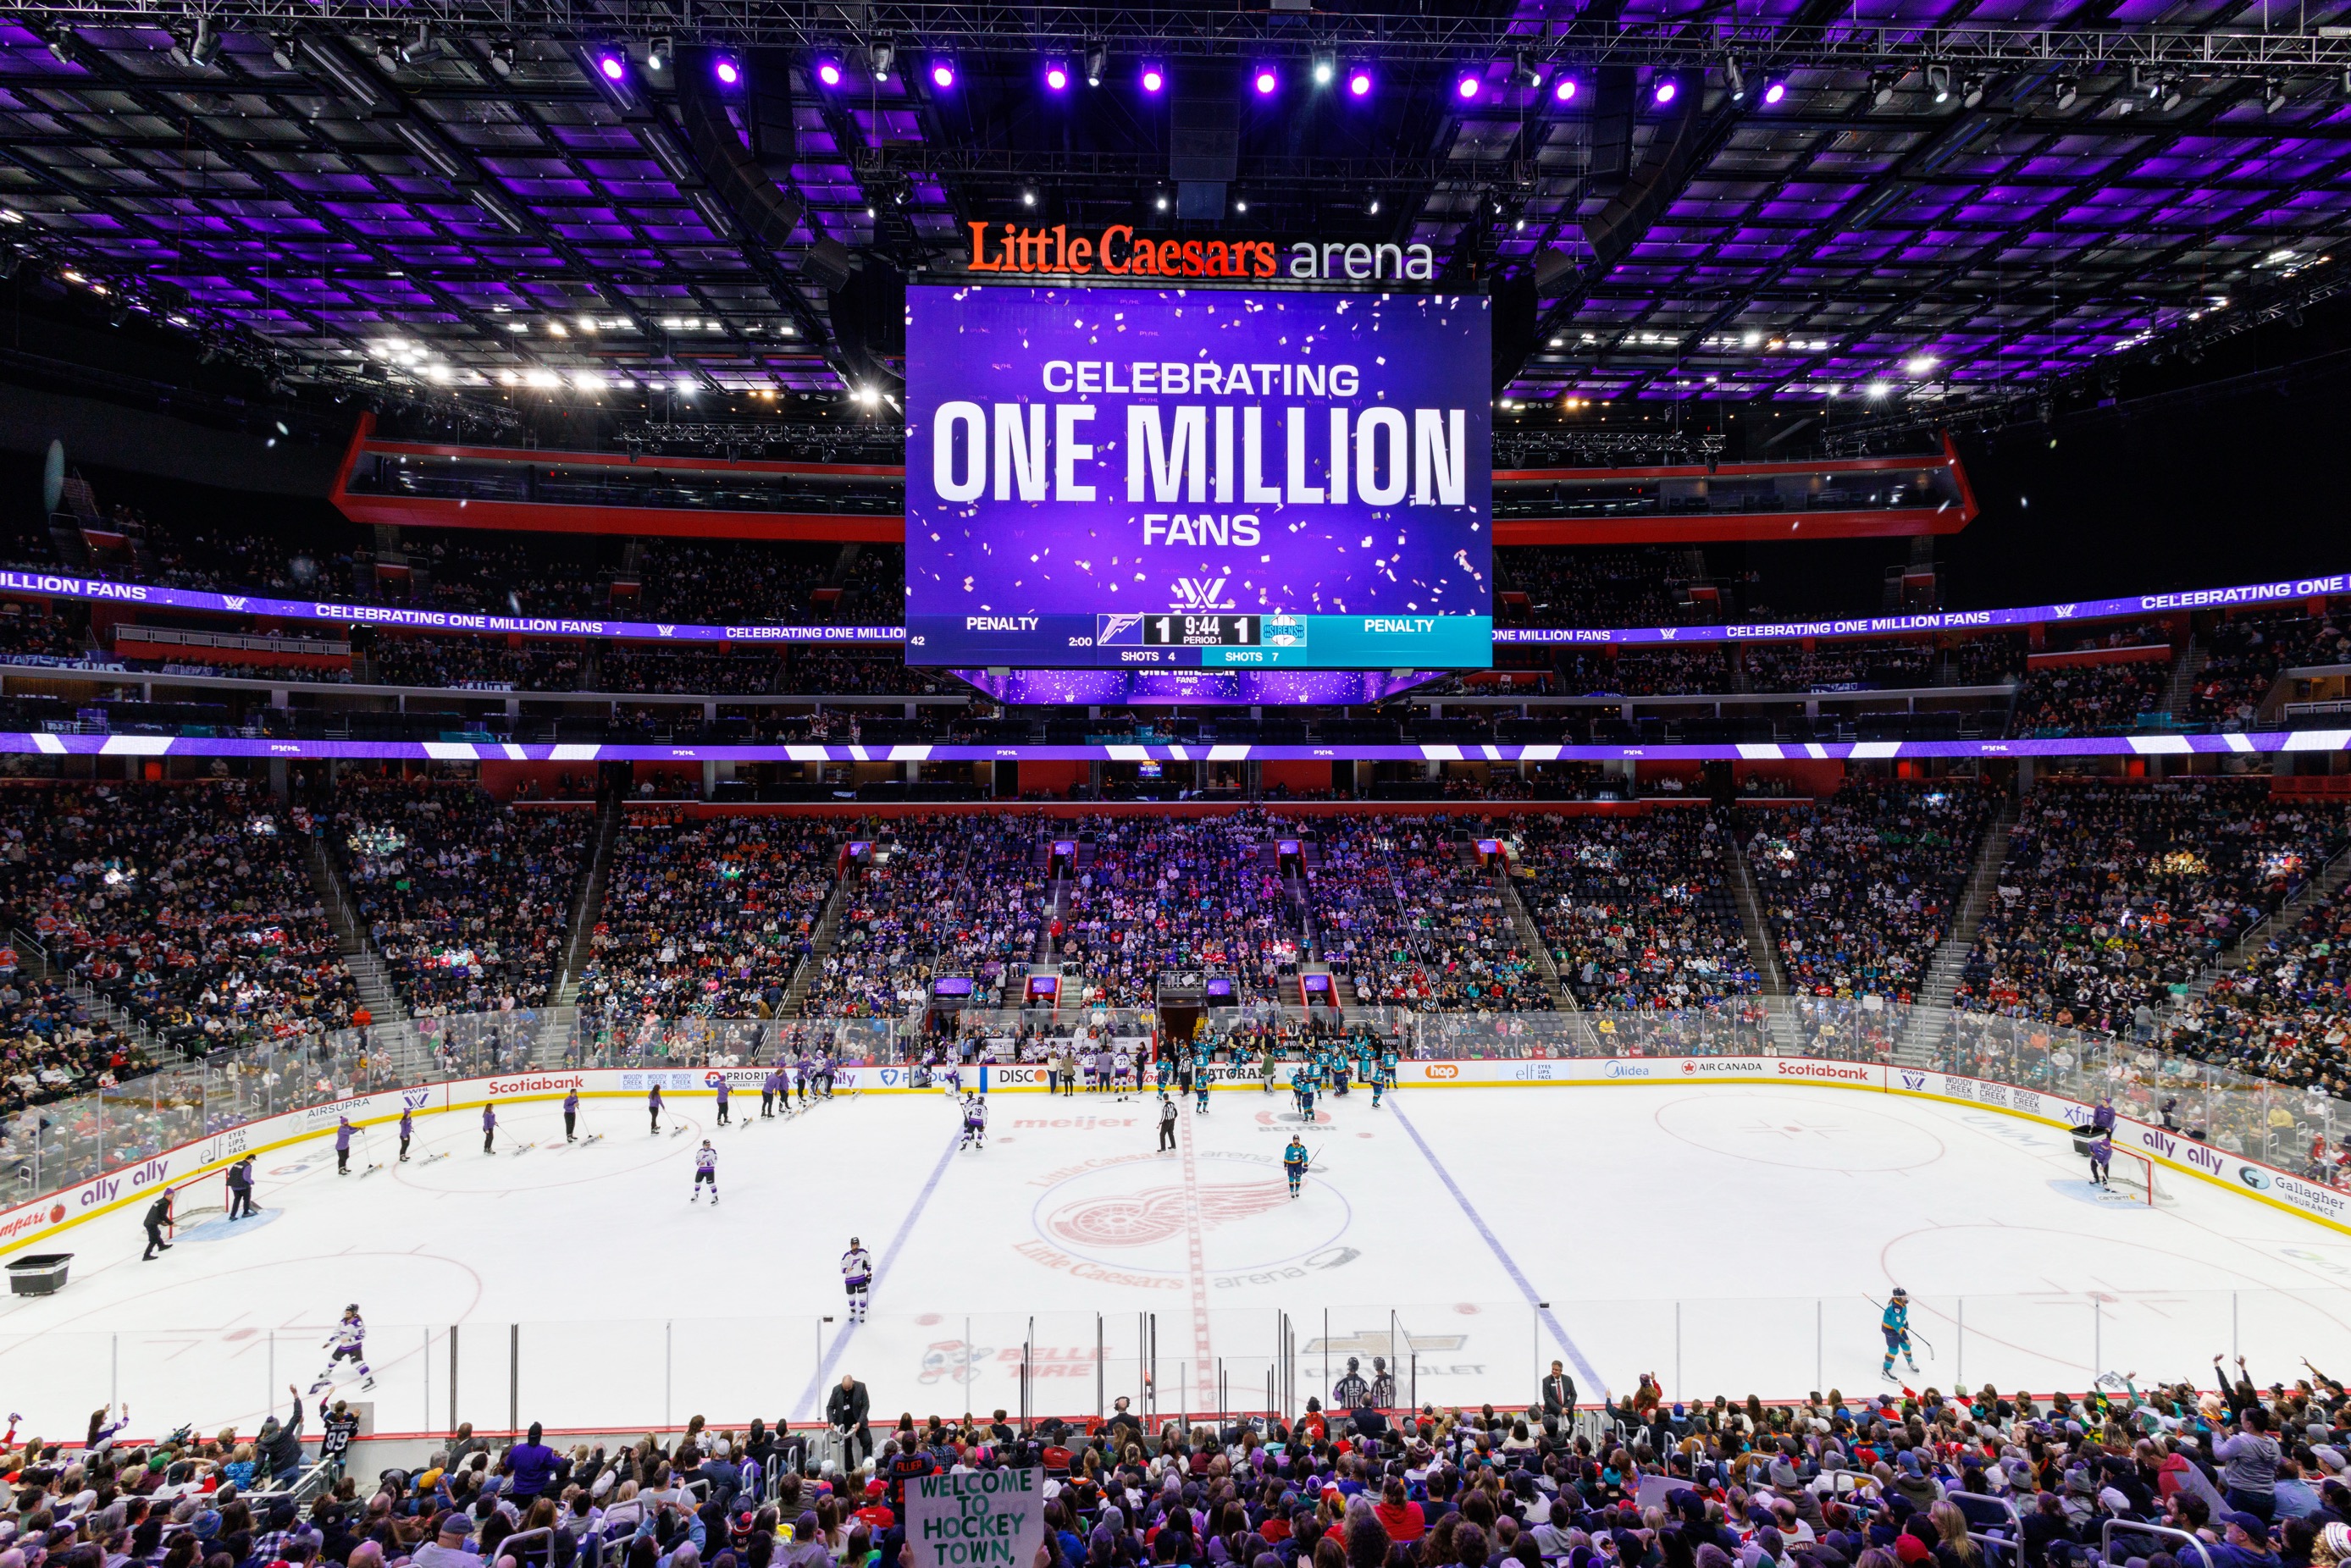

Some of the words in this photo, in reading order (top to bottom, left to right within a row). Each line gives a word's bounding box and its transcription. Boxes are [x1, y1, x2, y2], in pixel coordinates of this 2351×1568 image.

[967, 221, 1093, 276] Little
[1100, 224, 1277, 278] Caesars
[1289, 242, 1433, 280] arena
[1043, 361, 1359, 397] CELEBRATING
[933, 401, 1096, 502] ONE
[1127, 406, 1465, 506] MILLION
[1143, 515, 1261, 546] FANS
[86, 582, 147, 600] FANS
[2141, 582, 2292, 610] CELEBRATING
[2297, 576, 2343, 595] ONE
[316, 605, 445, 623] CELEBRATING
[449, 615, 485, 628] ONE
[489, 616, 557, 632] MILLION
[561, 621, 603, 633] FANS
[966, 617, 1039, 631] PENALTY
[1185, 616, 1220, 634] 9:44
[1364, 619, 1435, 632] PENALTY
[1726, 621, 1831, 638] CELEBRATING
[1834, 620, 1868, 633] ONE
[1871, 613, 1939, 631] MILLION
[1944, 610, 1990, 627] FANS
[726, 627, 821, 639] CELEBRATING
[824, 627, 854, 638] ONE
[1155, 617, 1170, 643] 1
[1234, 617, 1248, 643] 1
[1268, 625, 1298, 637] SIRENS
[1519, 631, 1573, 642] MILLION
[1576, 631, 1611, 642] FANS
[910, 637, 925, 646] 42
[1068, 637, 1093, 647] 2:00
[1183, 636, 1216, 644] PERIOD
[1121, 651, 1159, 661] SHOTS
[1168, 651, 1176, 661] 4
[1225, 651, 1263, 662] SHOTS
[1272, 652, 1279, 662] 7
[1430, 1065, 1456, 1079] hap
[1613, 1065, 1649, 1076] Midea
[1699, 1063, 1716, 1071] AIR
[1718, 1063, 1762, 1071] CANADA
[1778, 1062, 1868, 1080] Scotiabank
[489, 1075, 584, 1095] Scotiabank
[1945, 1076, 1972, 1087] WOODY
[1945, 1084, 1972, 1095] CREEK
[1979, 1082, 2006, 1093] WOODY
[401, 1086, 430, 1096] PWHL
[1979, 1090, 2006, 1101] CREEK
[2014, 1089, 2041, 1100] WOODY
[307, 1097, 371, 1118] AIRSUPRA
[2014, 1096, 2041, 1107] CREEK
[1013, 1115, 1138, 1130] meijer
[2143, 1130, 2176, 1158] ally
[1026, 1163, 1083, 1189] Little
[1199, 1149, 1274, 1163] arena
[2188, 1147, 2223, 1176] ally
[133, 1160, 169, 1186] ally
[81, 1179, 120, 1206] ally
[2276, 1177, 2345, 1210] Gallagher
[2284, 1193, 2335, 1217] INSURANCE
[1012, 1239, 1070, 1269] Little
[1070, 1262, 1184, 1290] Caesars
[1213, 1266, 1307, 1289] arena
[997, 1347, 1113, 1361] BELLE
[1348, 1387, 1359, 1396] 25
[1381, 1386, 1391, 1396] 31
[326, 1431, 350, 1450] 99
[921, 1469, 1032, 1498] WELCOME
[957, 1494, 989, 1517] TO
[924, 1512, 1026, 1539] HOCKEY
[934, 1538, 1015, 1565] TOWN,
